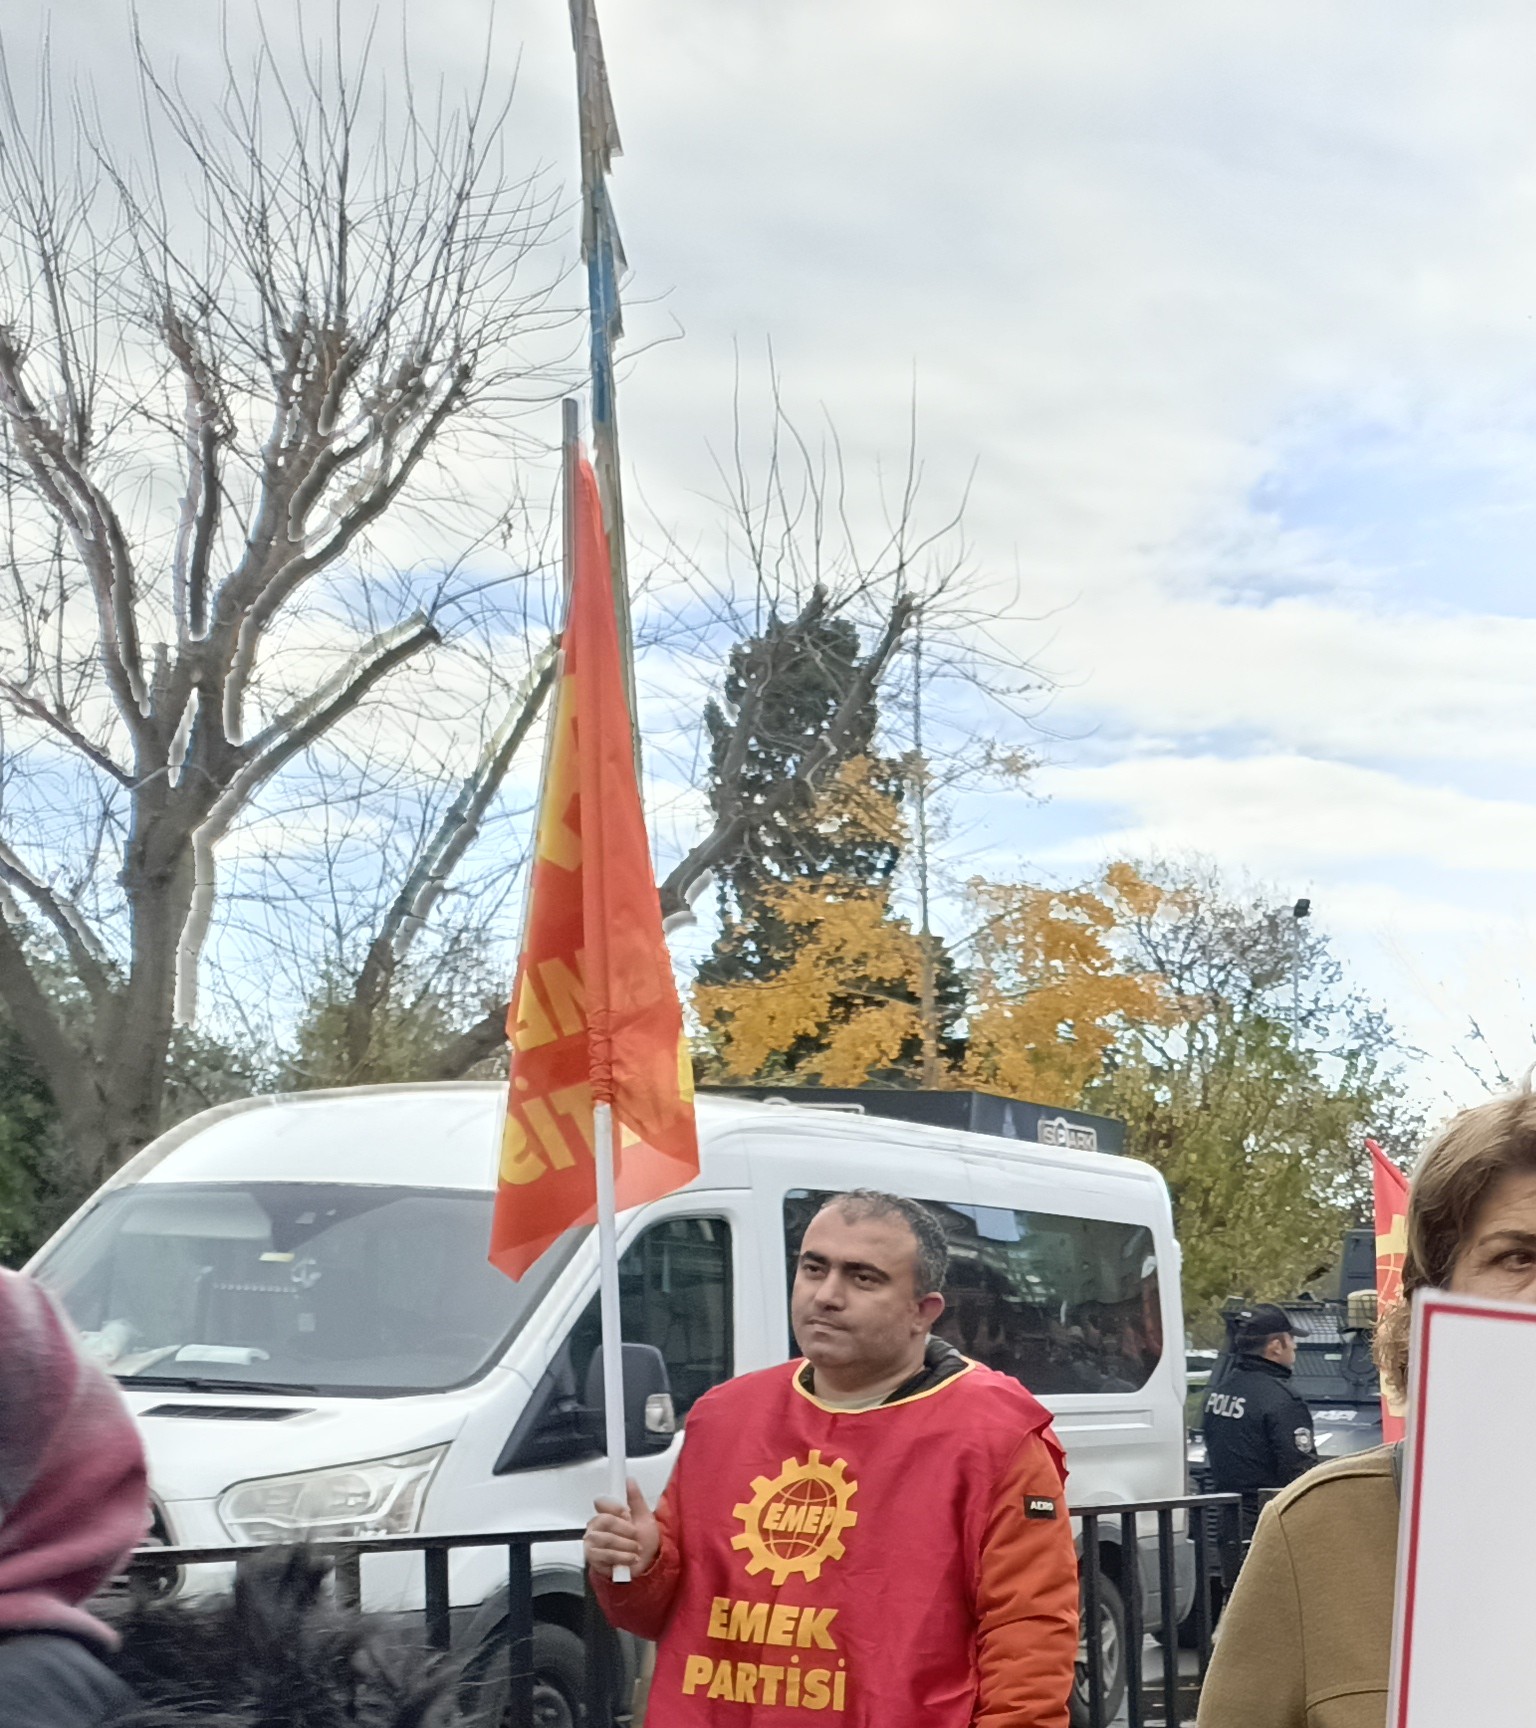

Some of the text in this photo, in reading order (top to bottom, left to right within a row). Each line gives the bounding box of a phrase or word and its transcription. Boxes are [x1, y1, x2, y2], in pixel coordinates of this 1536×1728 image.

[762, 1502, 837, 1535] EMEP
[707, 1597, 839, 1650] EMEK
[682, 1654, 846, 1711] PARTİSİ
